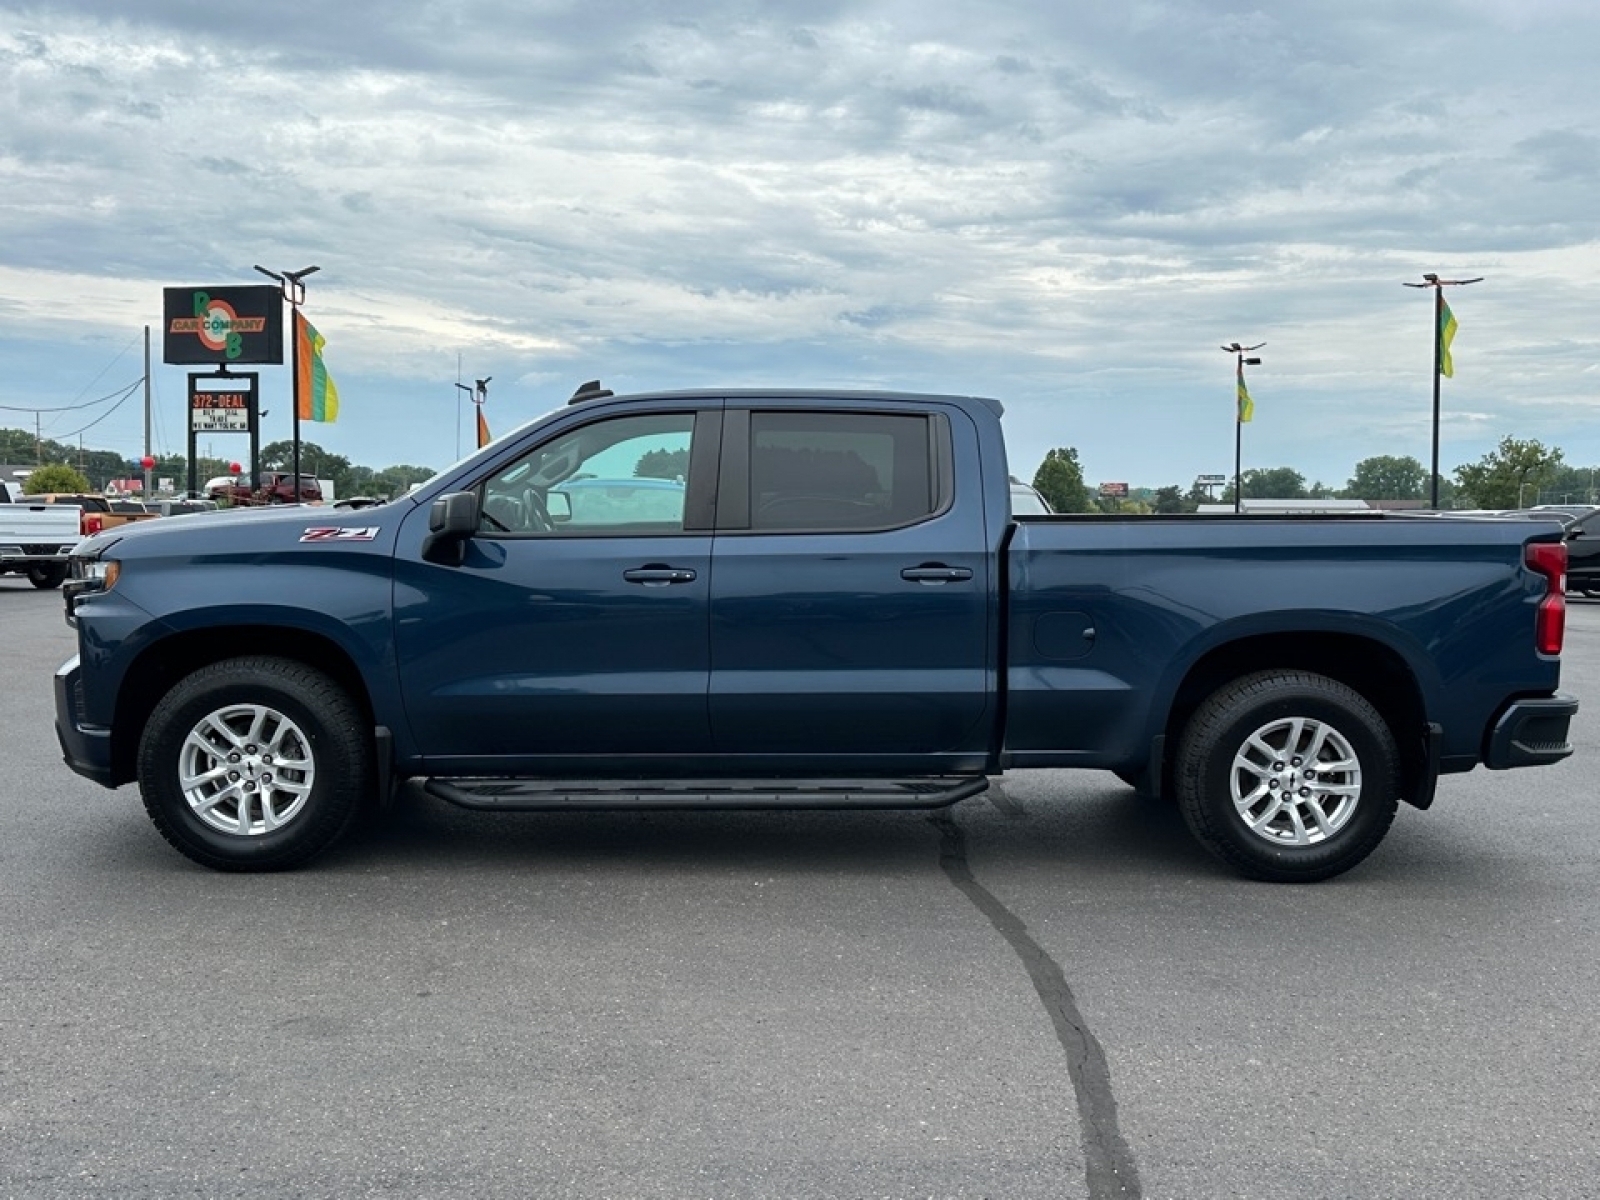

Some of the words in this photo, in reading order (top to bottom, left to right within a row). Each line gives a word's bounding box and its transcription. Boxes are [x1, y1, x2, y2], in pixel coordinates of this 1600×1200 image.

[173, 319, 198, 330] CAR
[204, 319, 262, 330] COMPANY
[193, 394, 245, 408] 372-DEAL
[299, 526, 381, 543] Z71
